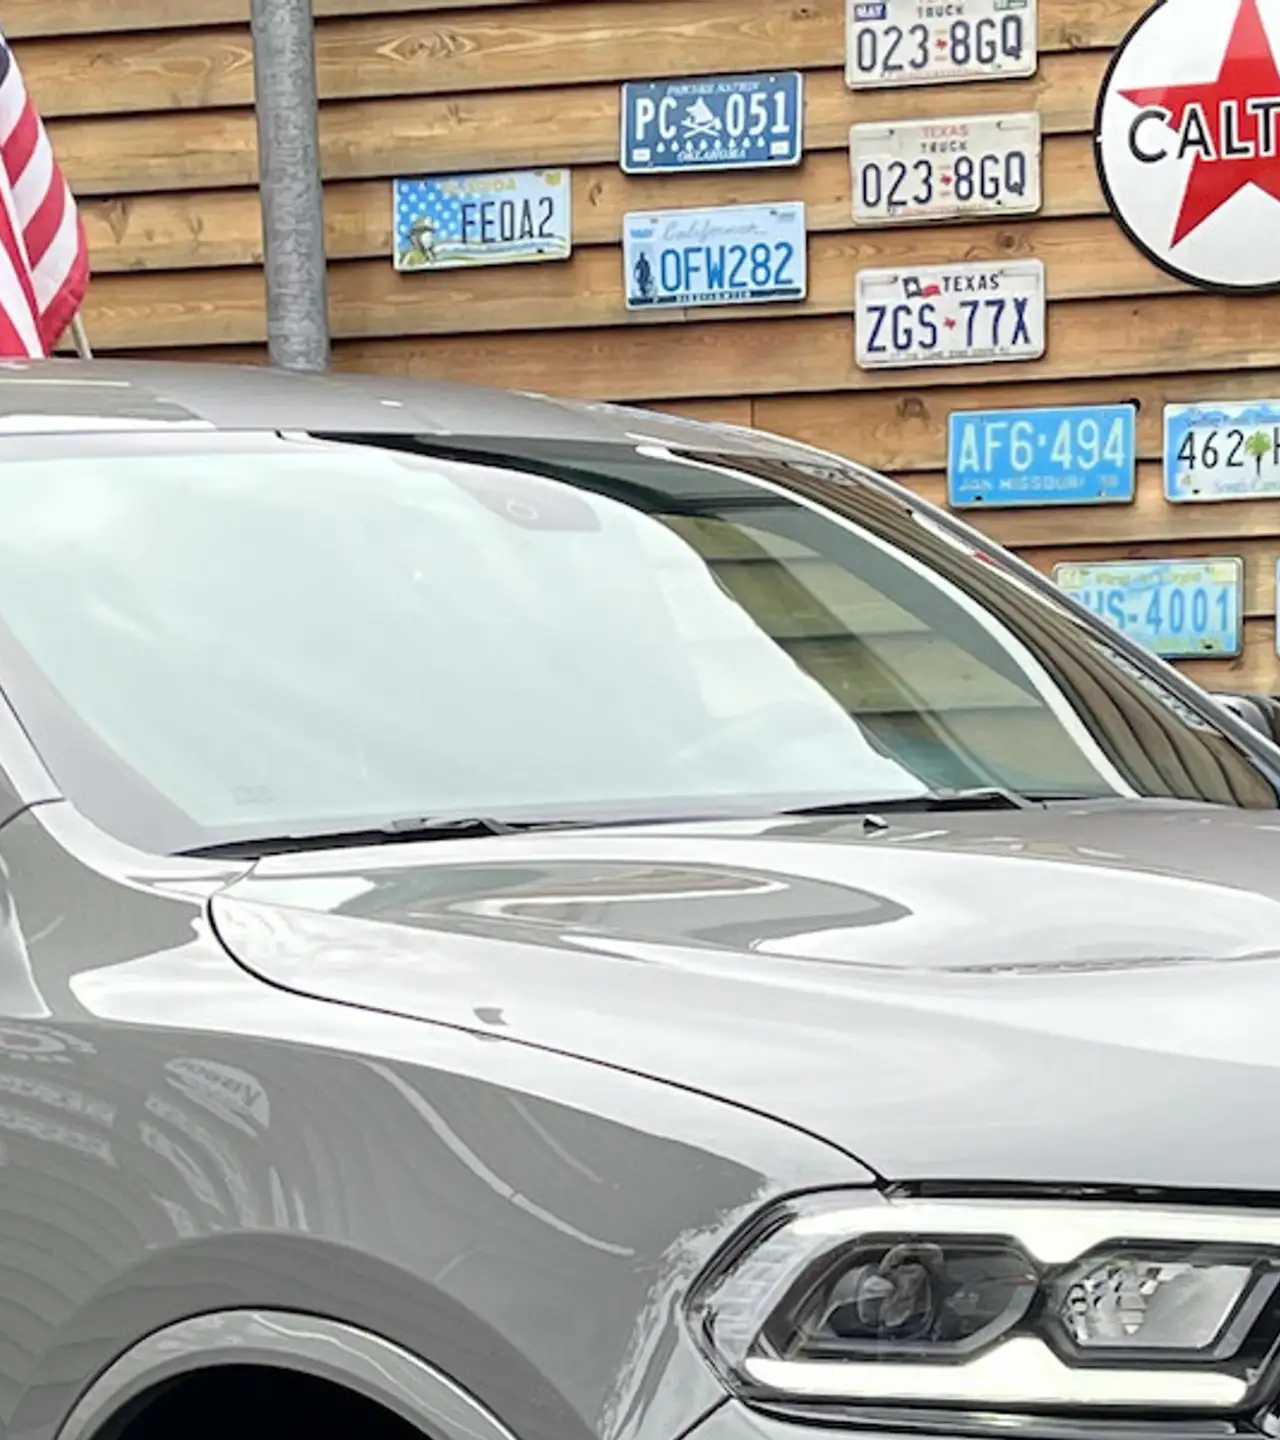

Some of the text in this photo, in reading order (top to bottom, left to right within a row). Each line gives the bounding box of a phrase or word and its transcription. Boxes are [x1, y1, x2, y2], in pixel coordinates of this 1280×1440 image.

[917, 4, 965, 18] TRUCK
[635, 91, 790, 140] PC 051
[922, 124, 969, 138] TEXAS
[921, 140, 968, 153] TRUCK
[942, 274, 1000, 292] TEXAS
